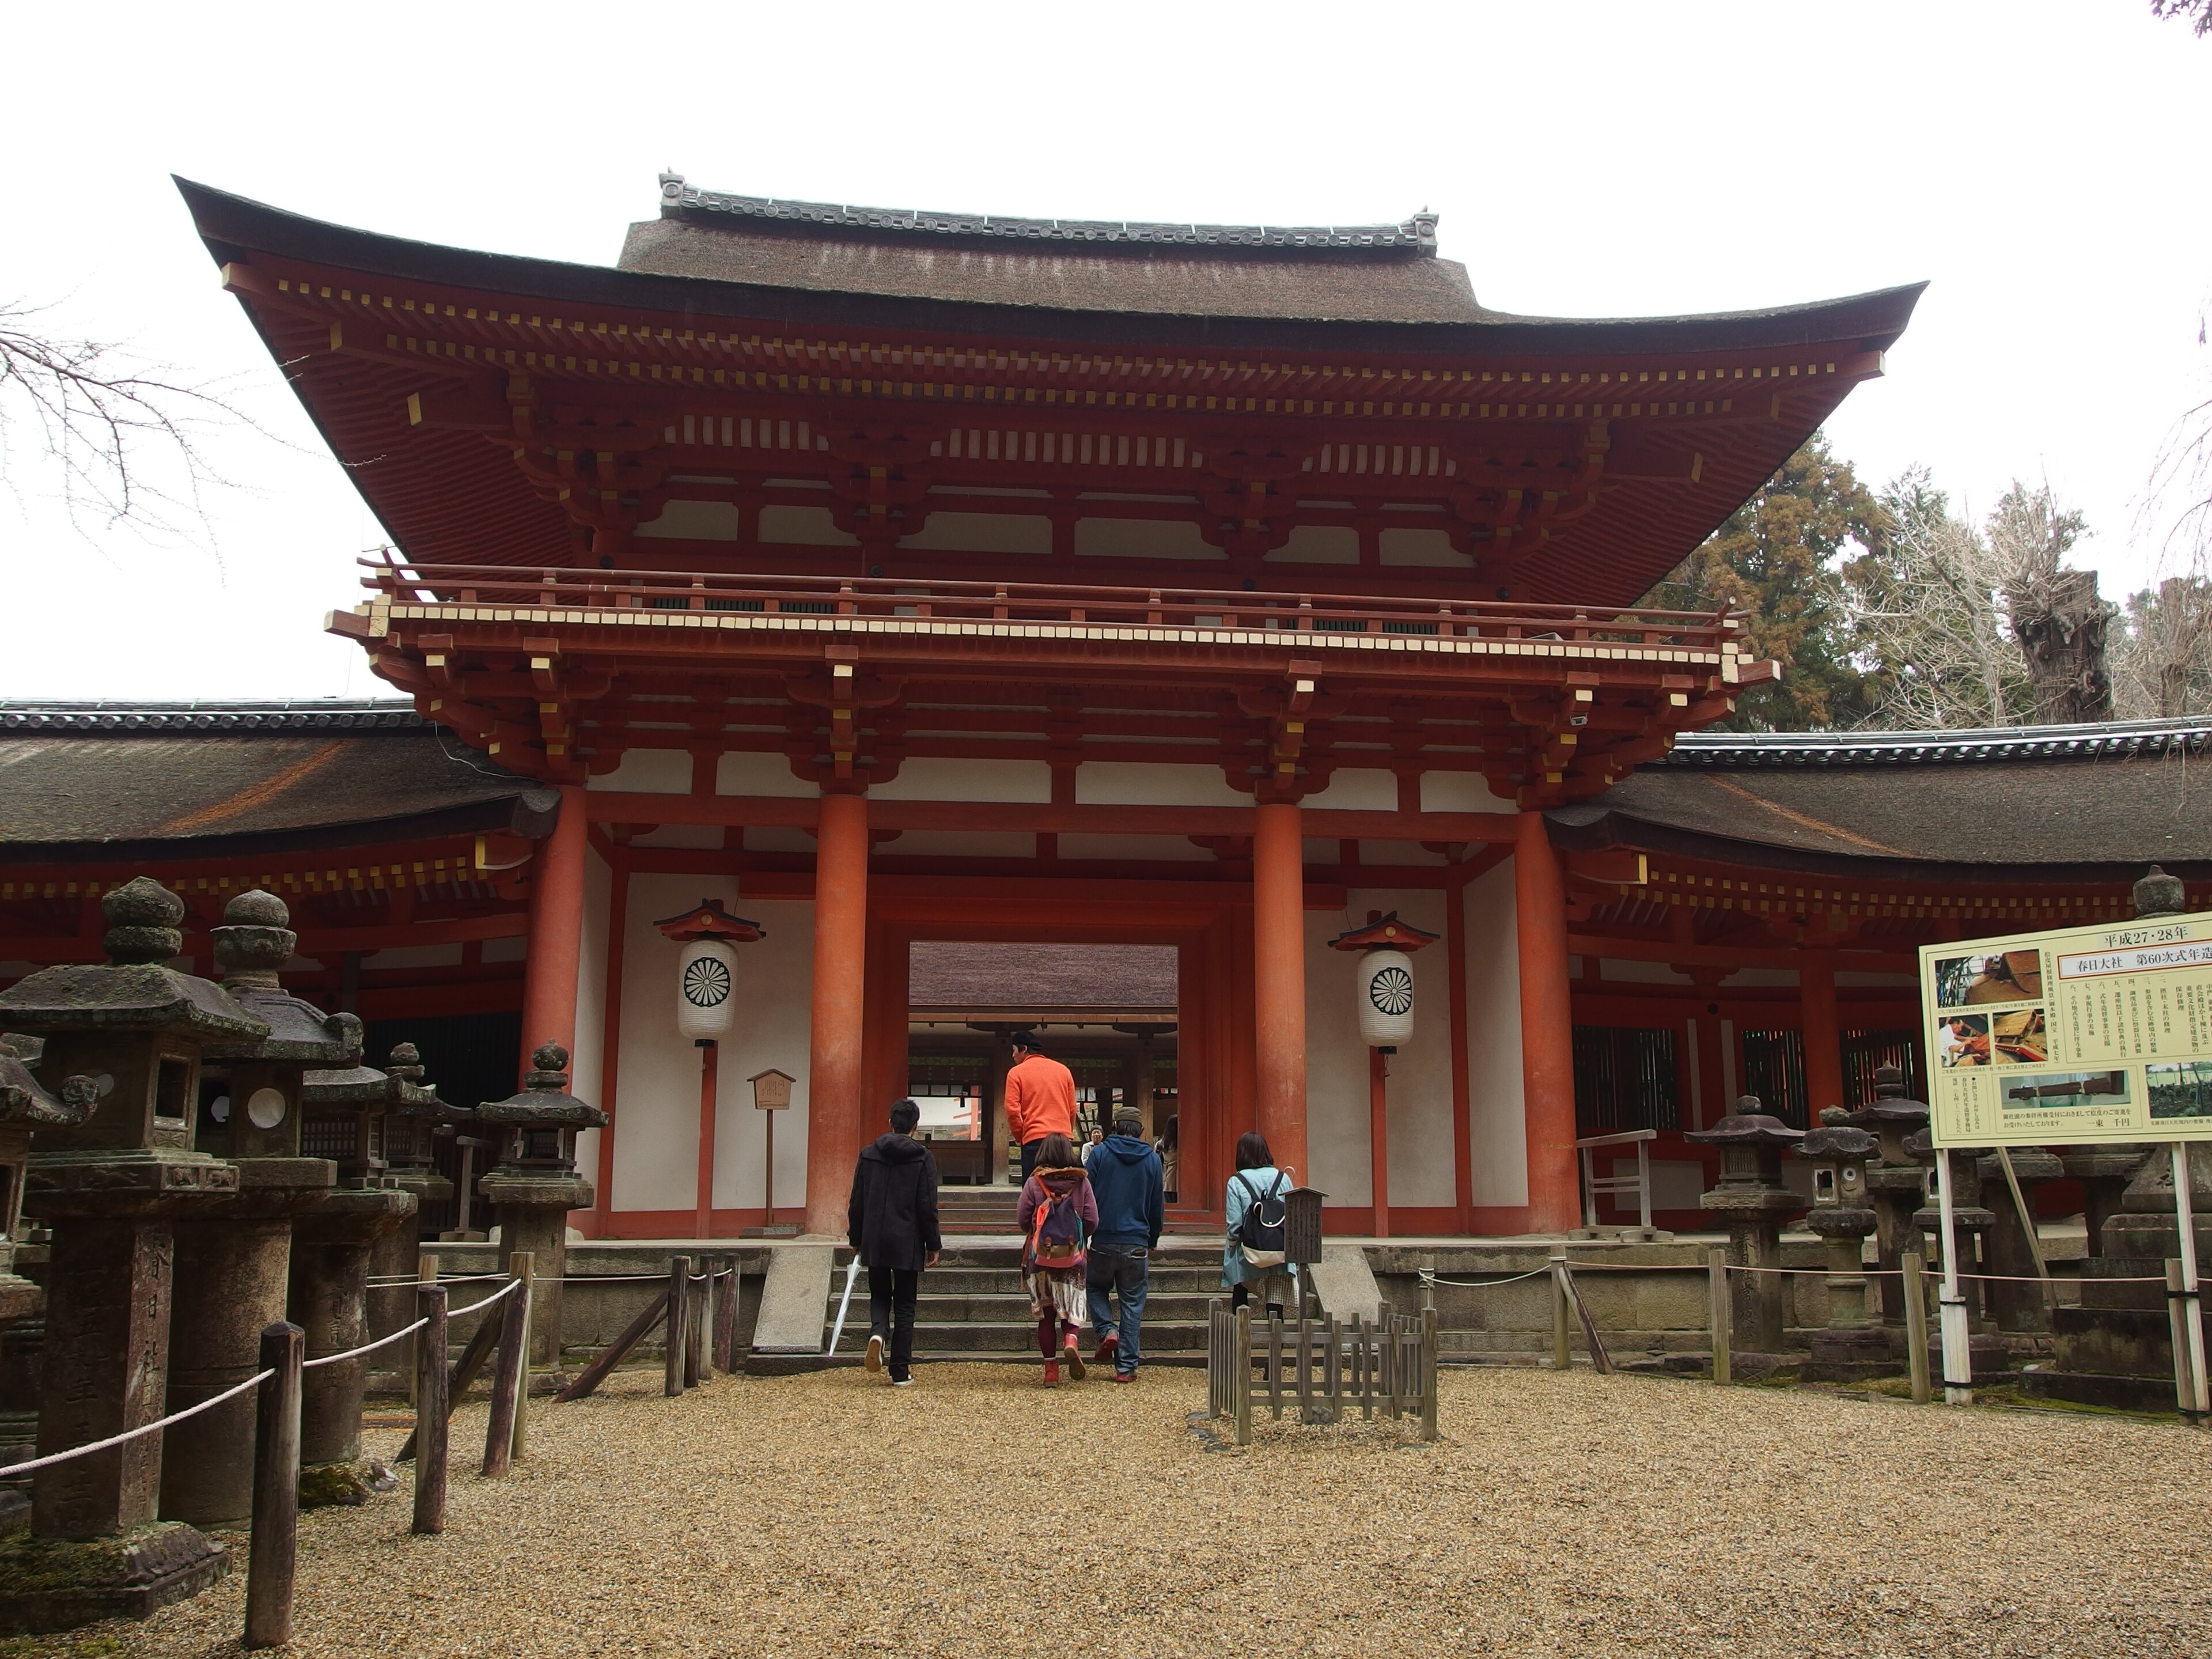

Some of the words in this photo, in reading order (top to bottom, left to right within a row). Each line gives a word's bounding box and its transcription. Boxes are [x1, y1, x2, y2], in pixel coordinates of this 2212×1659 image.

[2104, 926, 2188, 948] 平成27・28年
[2078, 956, 2123, 972] 春日大社
[2136, 946, 2212, 966] 第60次式年造
[2112, 1118, 2130, 1127] 千円
